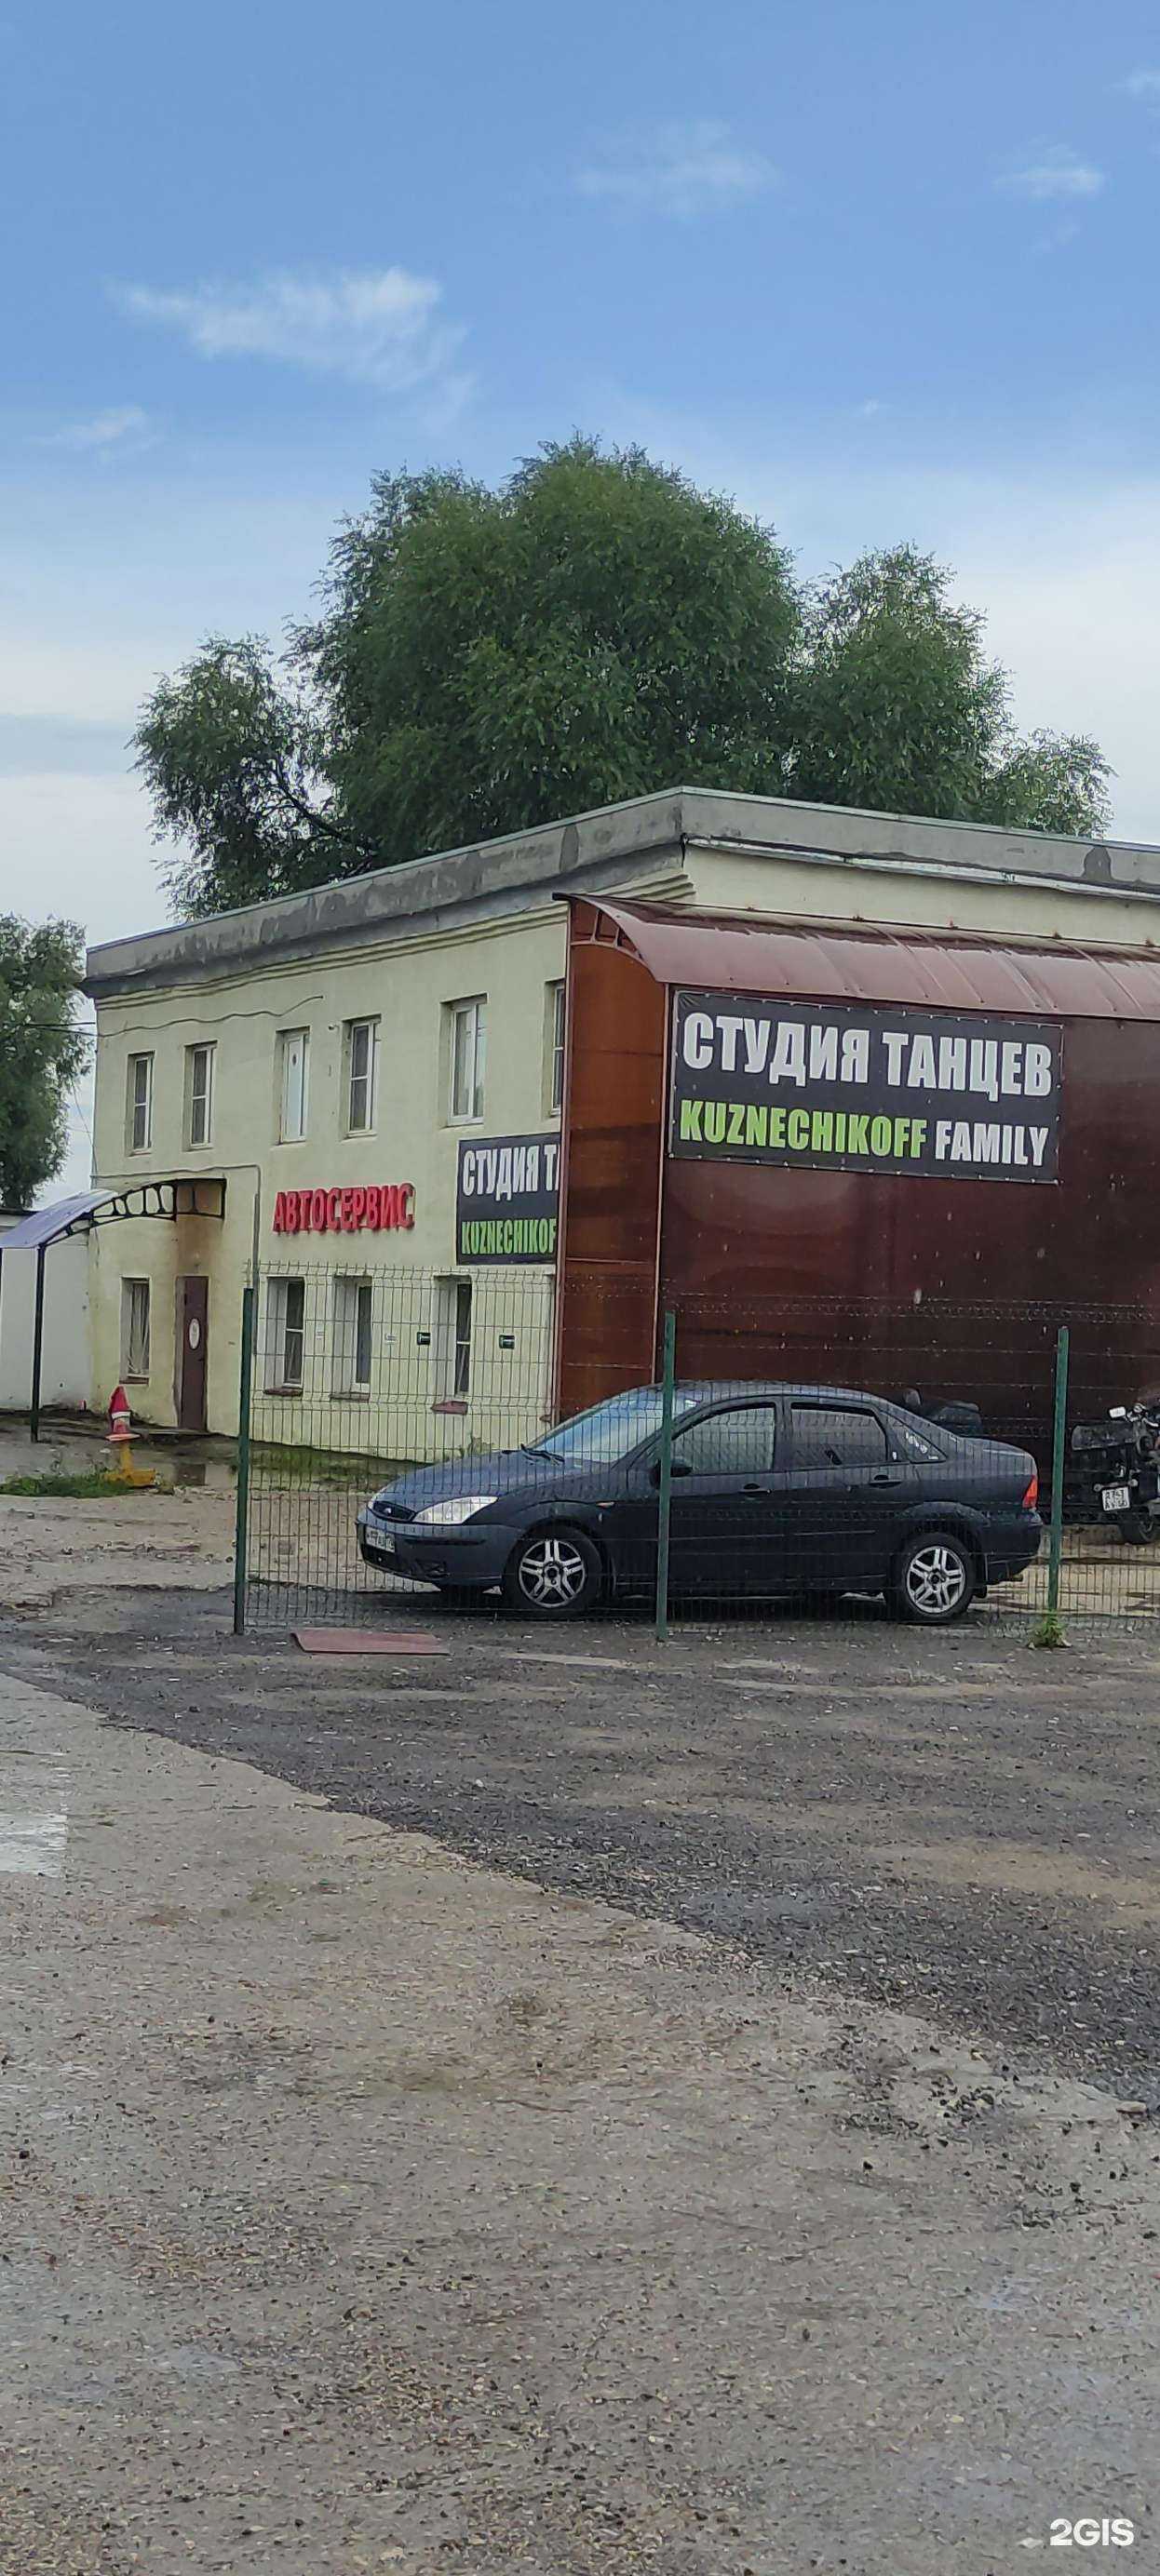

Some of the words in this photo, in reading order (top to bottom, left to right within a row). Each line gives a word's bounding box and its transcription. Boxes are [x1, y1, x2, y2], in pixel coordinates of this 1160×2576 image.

[682, 1012, 870, 1087] СТУДИЯ
[882, 1031, 1052, 1102] ТАНЦЕВ
[680, 1099, 927, 1159] KUZNECHIKOFF
[934, 1120, 1049, 1166] FAMILY
[462, 1145, 539, 1201] СТУДИЯ
[273, 1182, 416, 1235] АВТОСЕРВИС
